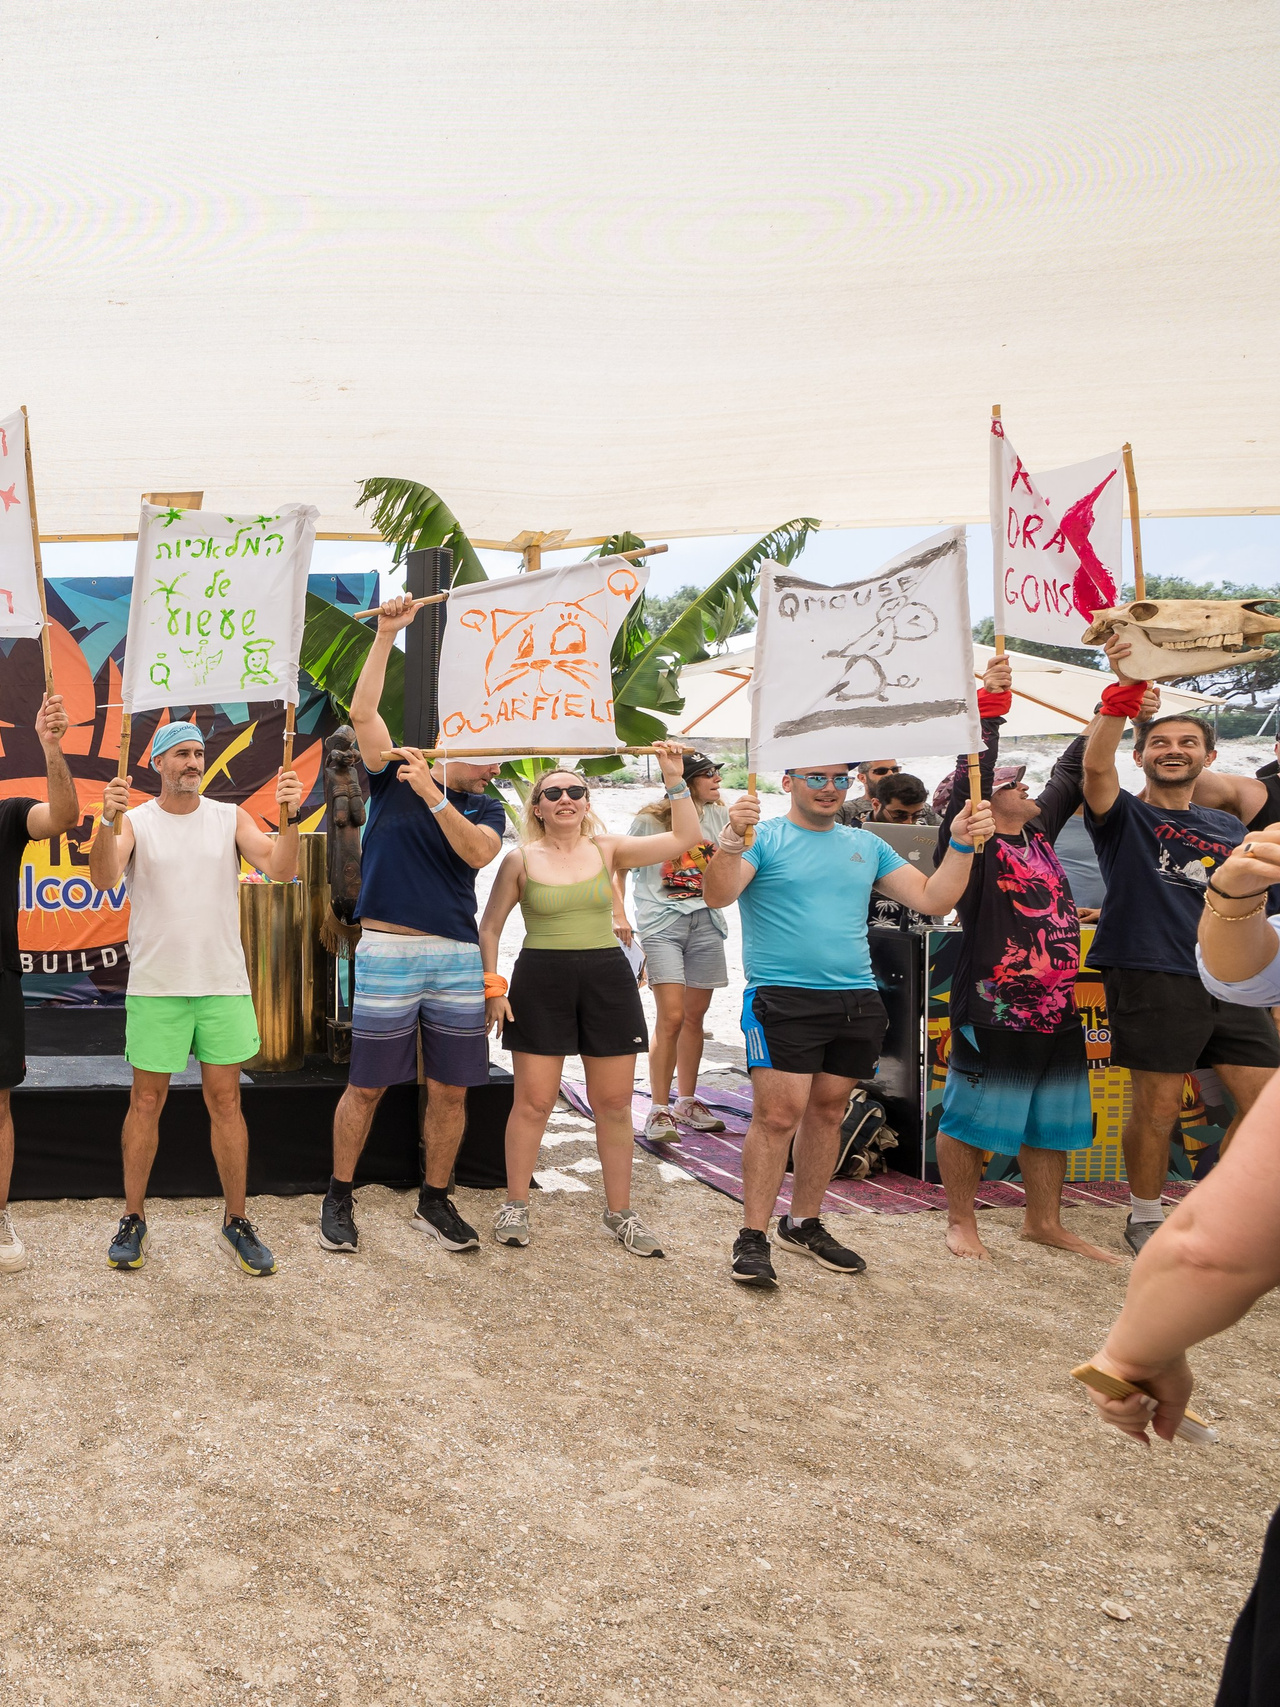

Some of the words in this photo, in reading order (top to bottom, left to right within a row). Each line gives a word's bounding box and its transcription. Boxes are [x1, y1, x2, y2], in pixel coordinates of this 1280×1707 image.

[156, 527, 284, 559] המלאכיות
[204, 568, 232, 598] של
[778, 576, 912, 622] QMOUSE
[166, 607, 257, 640] שעשוע
